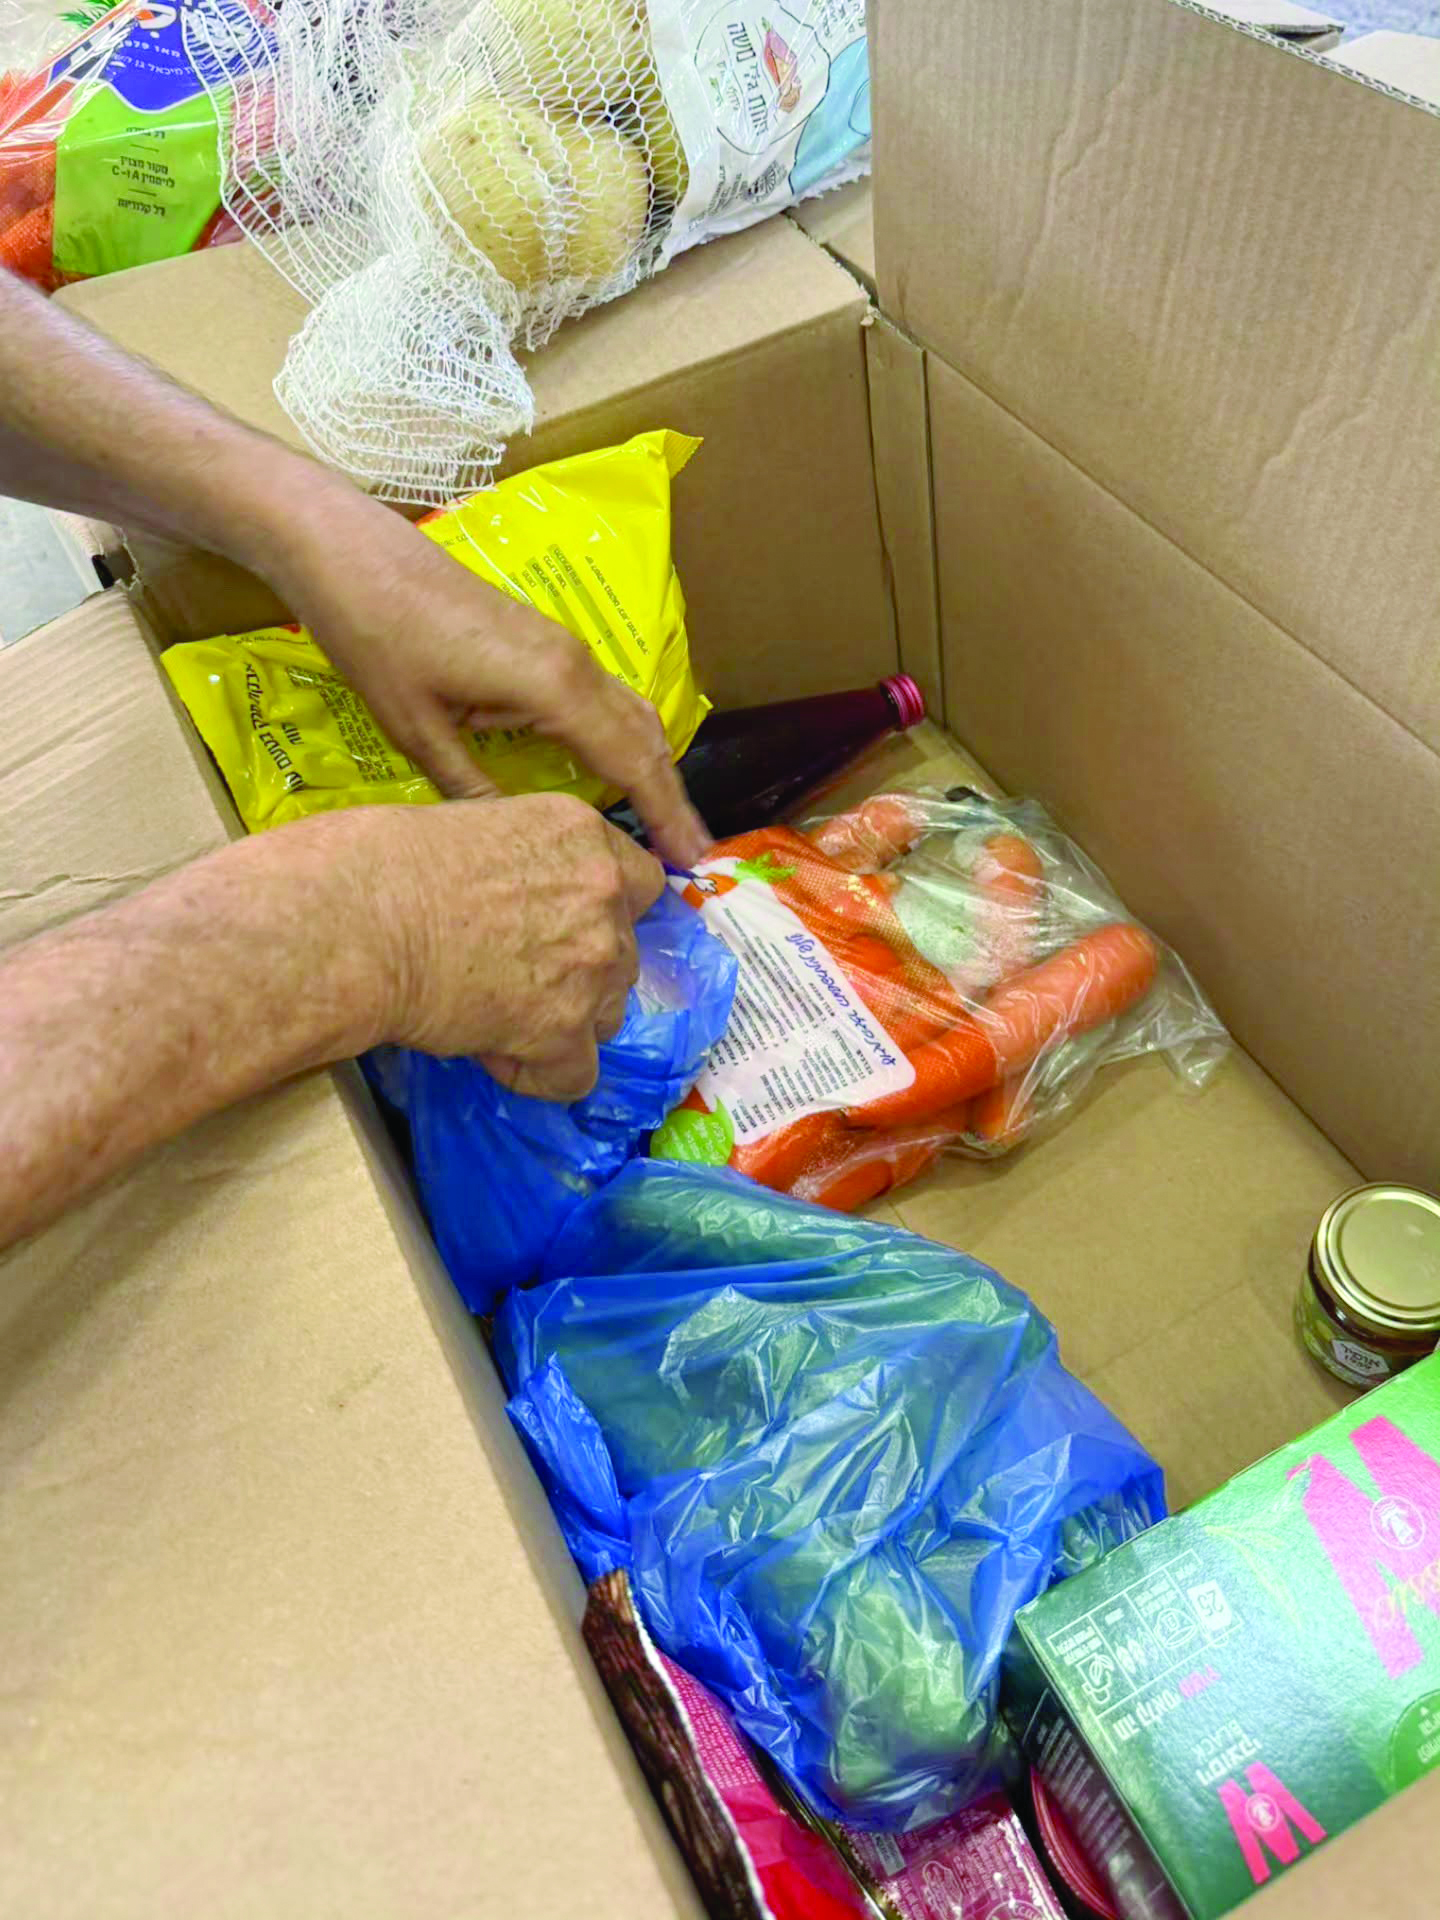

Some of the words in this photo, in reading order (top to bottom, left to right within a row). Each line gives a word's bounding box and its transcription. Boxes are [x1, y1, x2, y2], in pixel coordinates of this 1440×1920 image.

[131, 170, 140, 179] A
[147, 161, 168, 174] מקור
[259, 732, 292, 772] בטעם
[1112, 1718, 1140, 1742] תה
[1134, 1686, 1181, 1727] קלאסי
[1188, 1718, 1246, 1763] BLACK
[1197, 1737, 1262, 1785] ויסוצקי
